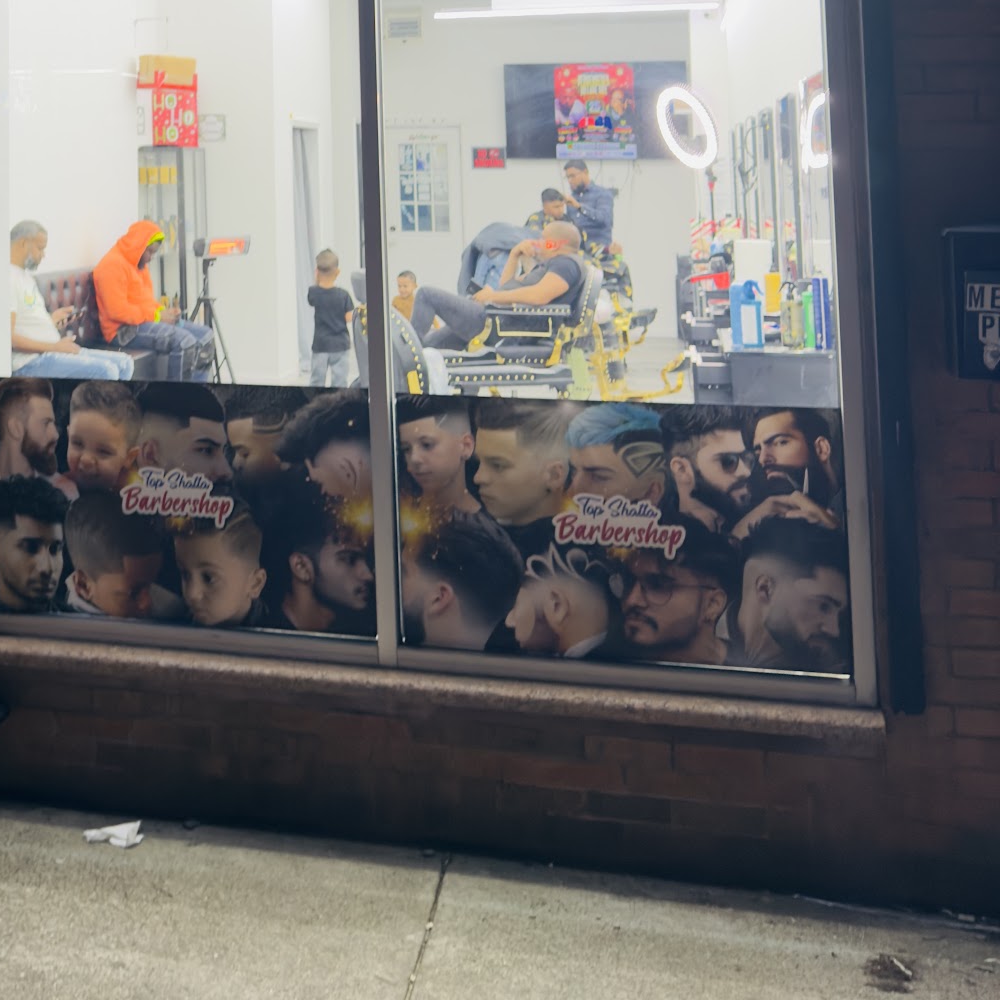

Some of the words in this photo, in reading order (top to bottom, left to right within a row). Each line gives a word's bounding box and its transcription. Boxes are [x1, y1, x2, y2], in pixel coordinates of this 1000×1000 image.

[981, 314, 1000, 340] P
[141, 470, 166, 490] Top
[122, 486, 232, 525] Barbershop
[575, 496, 605, 516] Top
[555, 513, 683, 555] Barbershop
